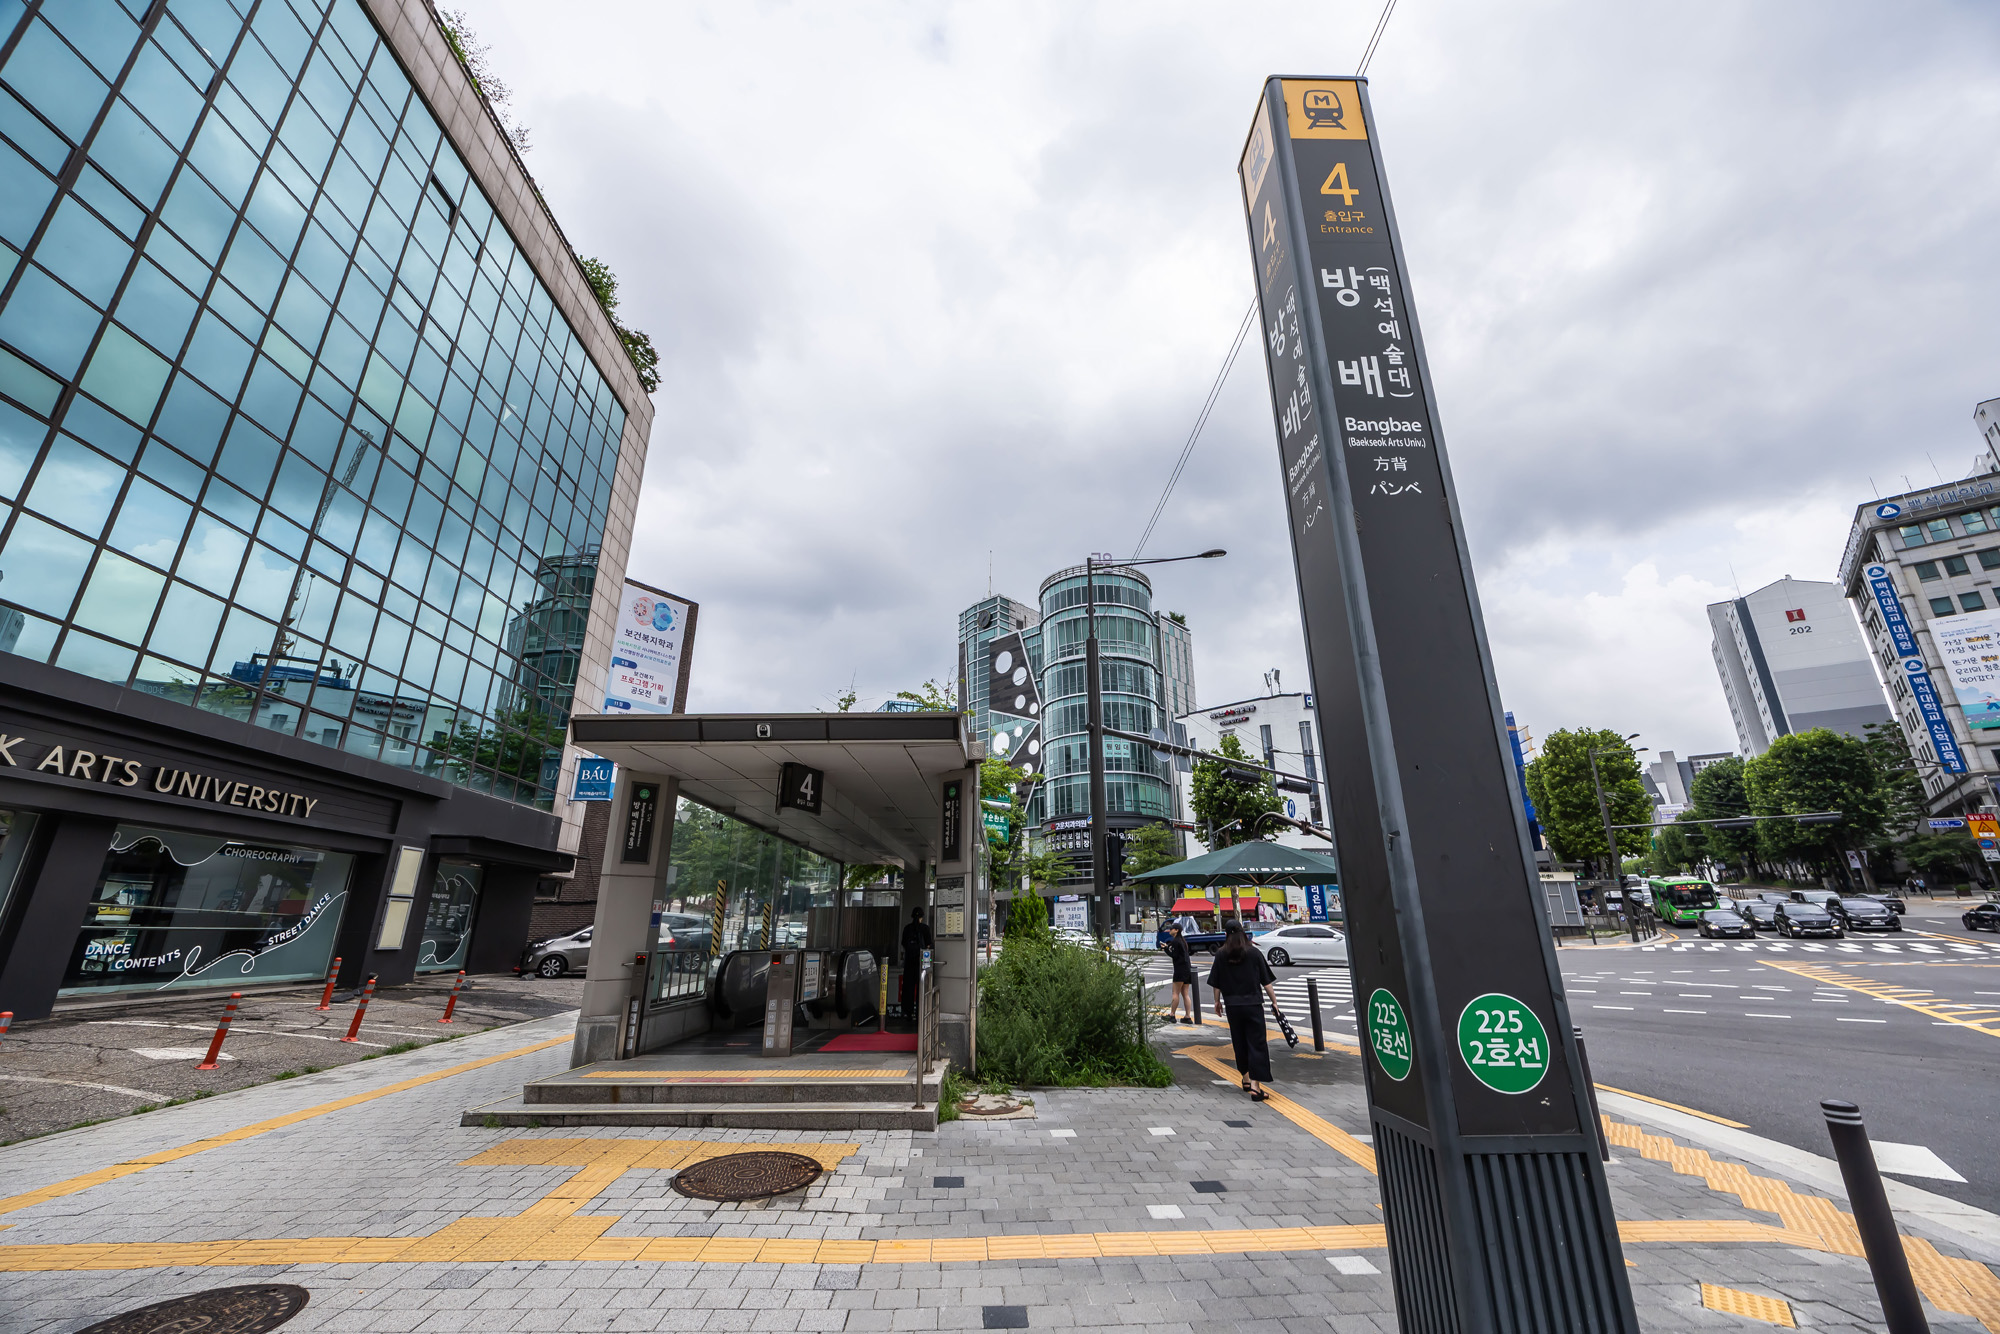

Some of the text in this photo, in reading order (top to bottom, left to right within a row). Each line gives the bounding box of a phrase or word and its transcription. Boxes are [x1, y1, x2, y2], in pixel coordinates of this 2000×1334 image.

[1320, 162, 1359, 206] 4
[1262, 199, 1276, 253] 4
[1324, 210, 1366, 222] 출입구
[1321, 224, 1374, 234] Entrance
[1366, 266, 1415, 398] (백석예술대)
[1345, 417, 1422, 436] Bangbae
[1348, 437, 1426, 448] (Baekseok Arts Univ.)
[1289, 434, 1318, 482] Bangbae
[1373, 456, 1407, 472] 方背
[1301, 481, 1315, 509] 方背
[1370, 481, 1422, 496] パンベ
[1907, 482, 1994, 510] 백석대학교
[1876, 581, 1913, 650] 백석대학교 대학원
[624, 628, 674, 650] 보건복지학과
[1789, 625, 1813, 635] 202
[1943, 638, 1962, 646] 가장
[1965, 633, 1992, 642] 뜨거운
[1968, 643, 1994, 651] 빛나는
[1952, 657, 1978, 666] 뜨거운
[1956, 666, 1981, 675] 우리의
[620, 675, 664, 692] 프로그램 기획
[630, 687, 652, 698] 공모전
[1913, 676, 1961, 770] 백석대학교 신학교육원
[0, 734, 319, 819] K ARTS UNIVERSITY
[800, 773, 814, 800] 4
[1055, 820, 1087, 830] 고운치과의원
[224, 848, 301, 864] CHOREOGRAPHY
[268, 892, 332, 946] STREET DANCE
[85, 944, 132, 956] DANCE
[115, 949, 181, 970] CONTENTS
[1374, 1002, 1397, 1026] 225
[1475, 1010, 1523, 1033] 225
[1374, 1028, 1410, 1061] 2호선
[1470, 1037, 1543, 1069] 2호선
